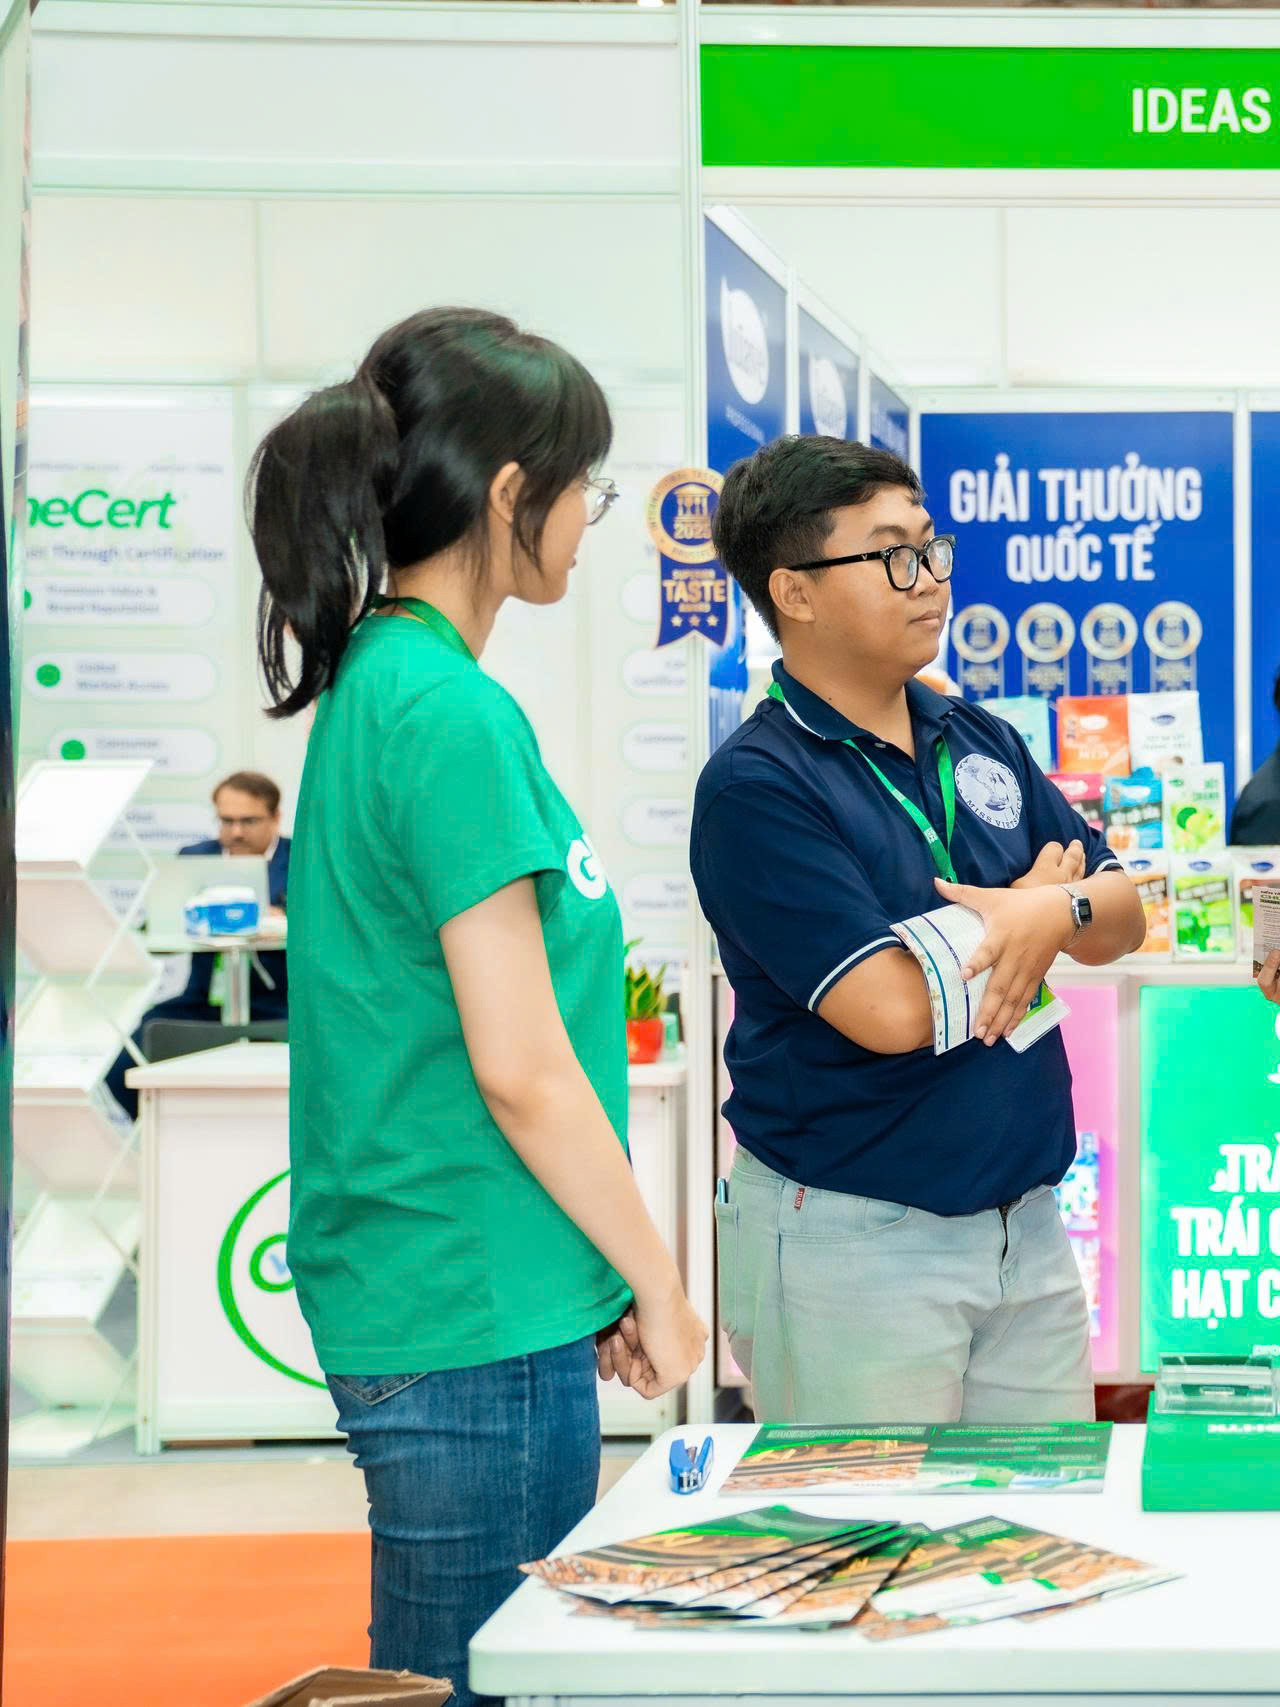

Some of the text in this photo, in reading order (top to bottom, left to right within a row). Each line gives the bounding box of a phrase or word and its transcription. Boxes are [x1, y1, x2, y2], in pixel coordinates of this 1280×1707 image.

[1132, 87, 1272, 134] IDEAS
[949, 451, 1202, 523] GIẢI THƯỞNG
[1006, 520, 1163, 584] QUỐC TẾ
[662, 578, 728, 604] TASTE
[1170, 1195, 1260, 1257] TRÁI
[1171, 1268, 1251, 1329] HẠT
